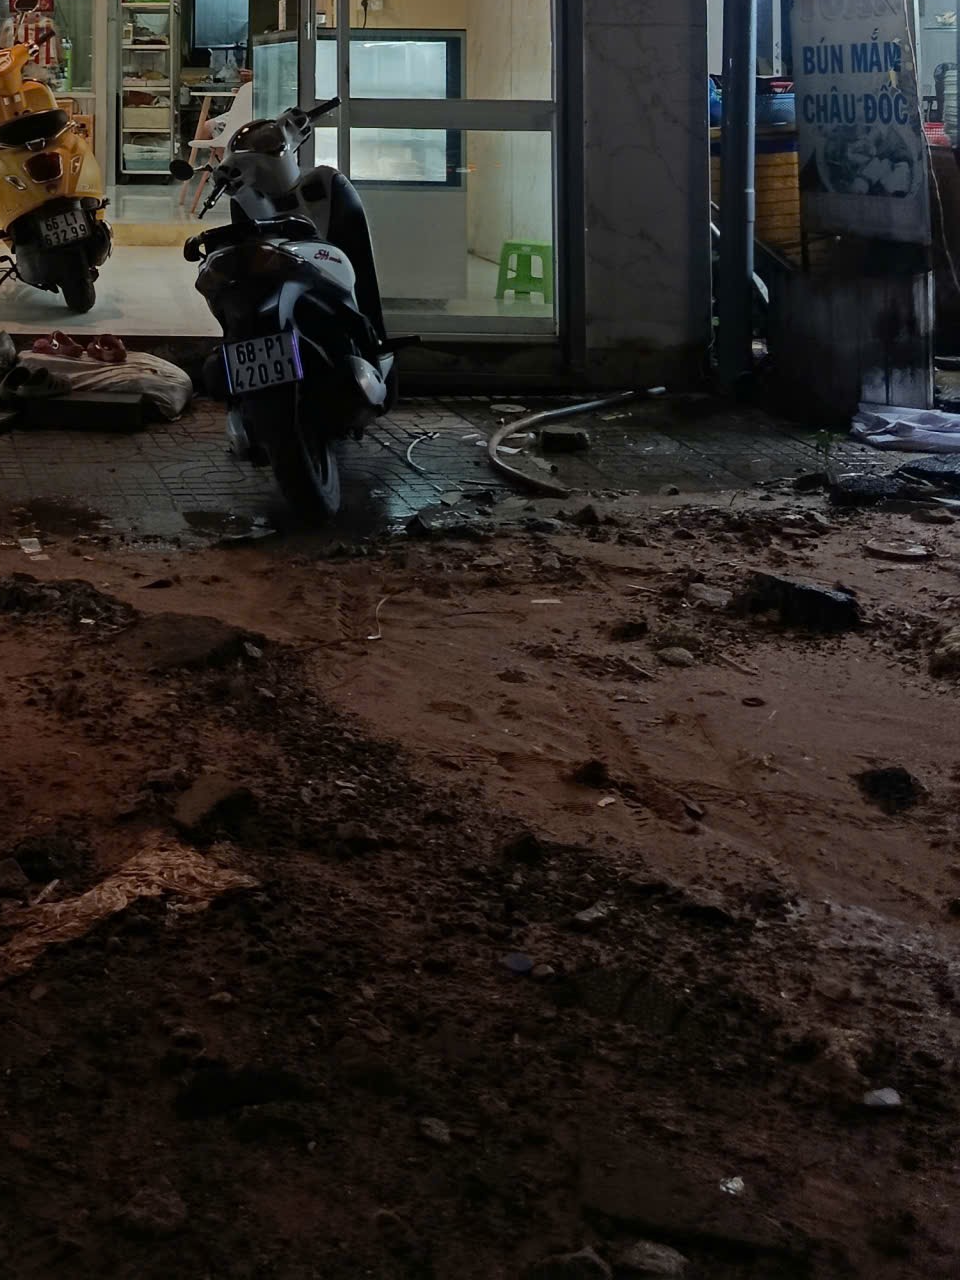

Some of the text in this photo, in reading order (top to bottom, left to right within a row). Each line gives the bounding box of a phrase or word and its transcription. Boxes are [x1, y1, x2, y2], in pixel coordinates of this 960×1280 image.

[802, 28, 902, 75] BÚN MẮM
[803, 86, 856, 124] CHÂU
[235, 335, 285, 365] 68-P1
